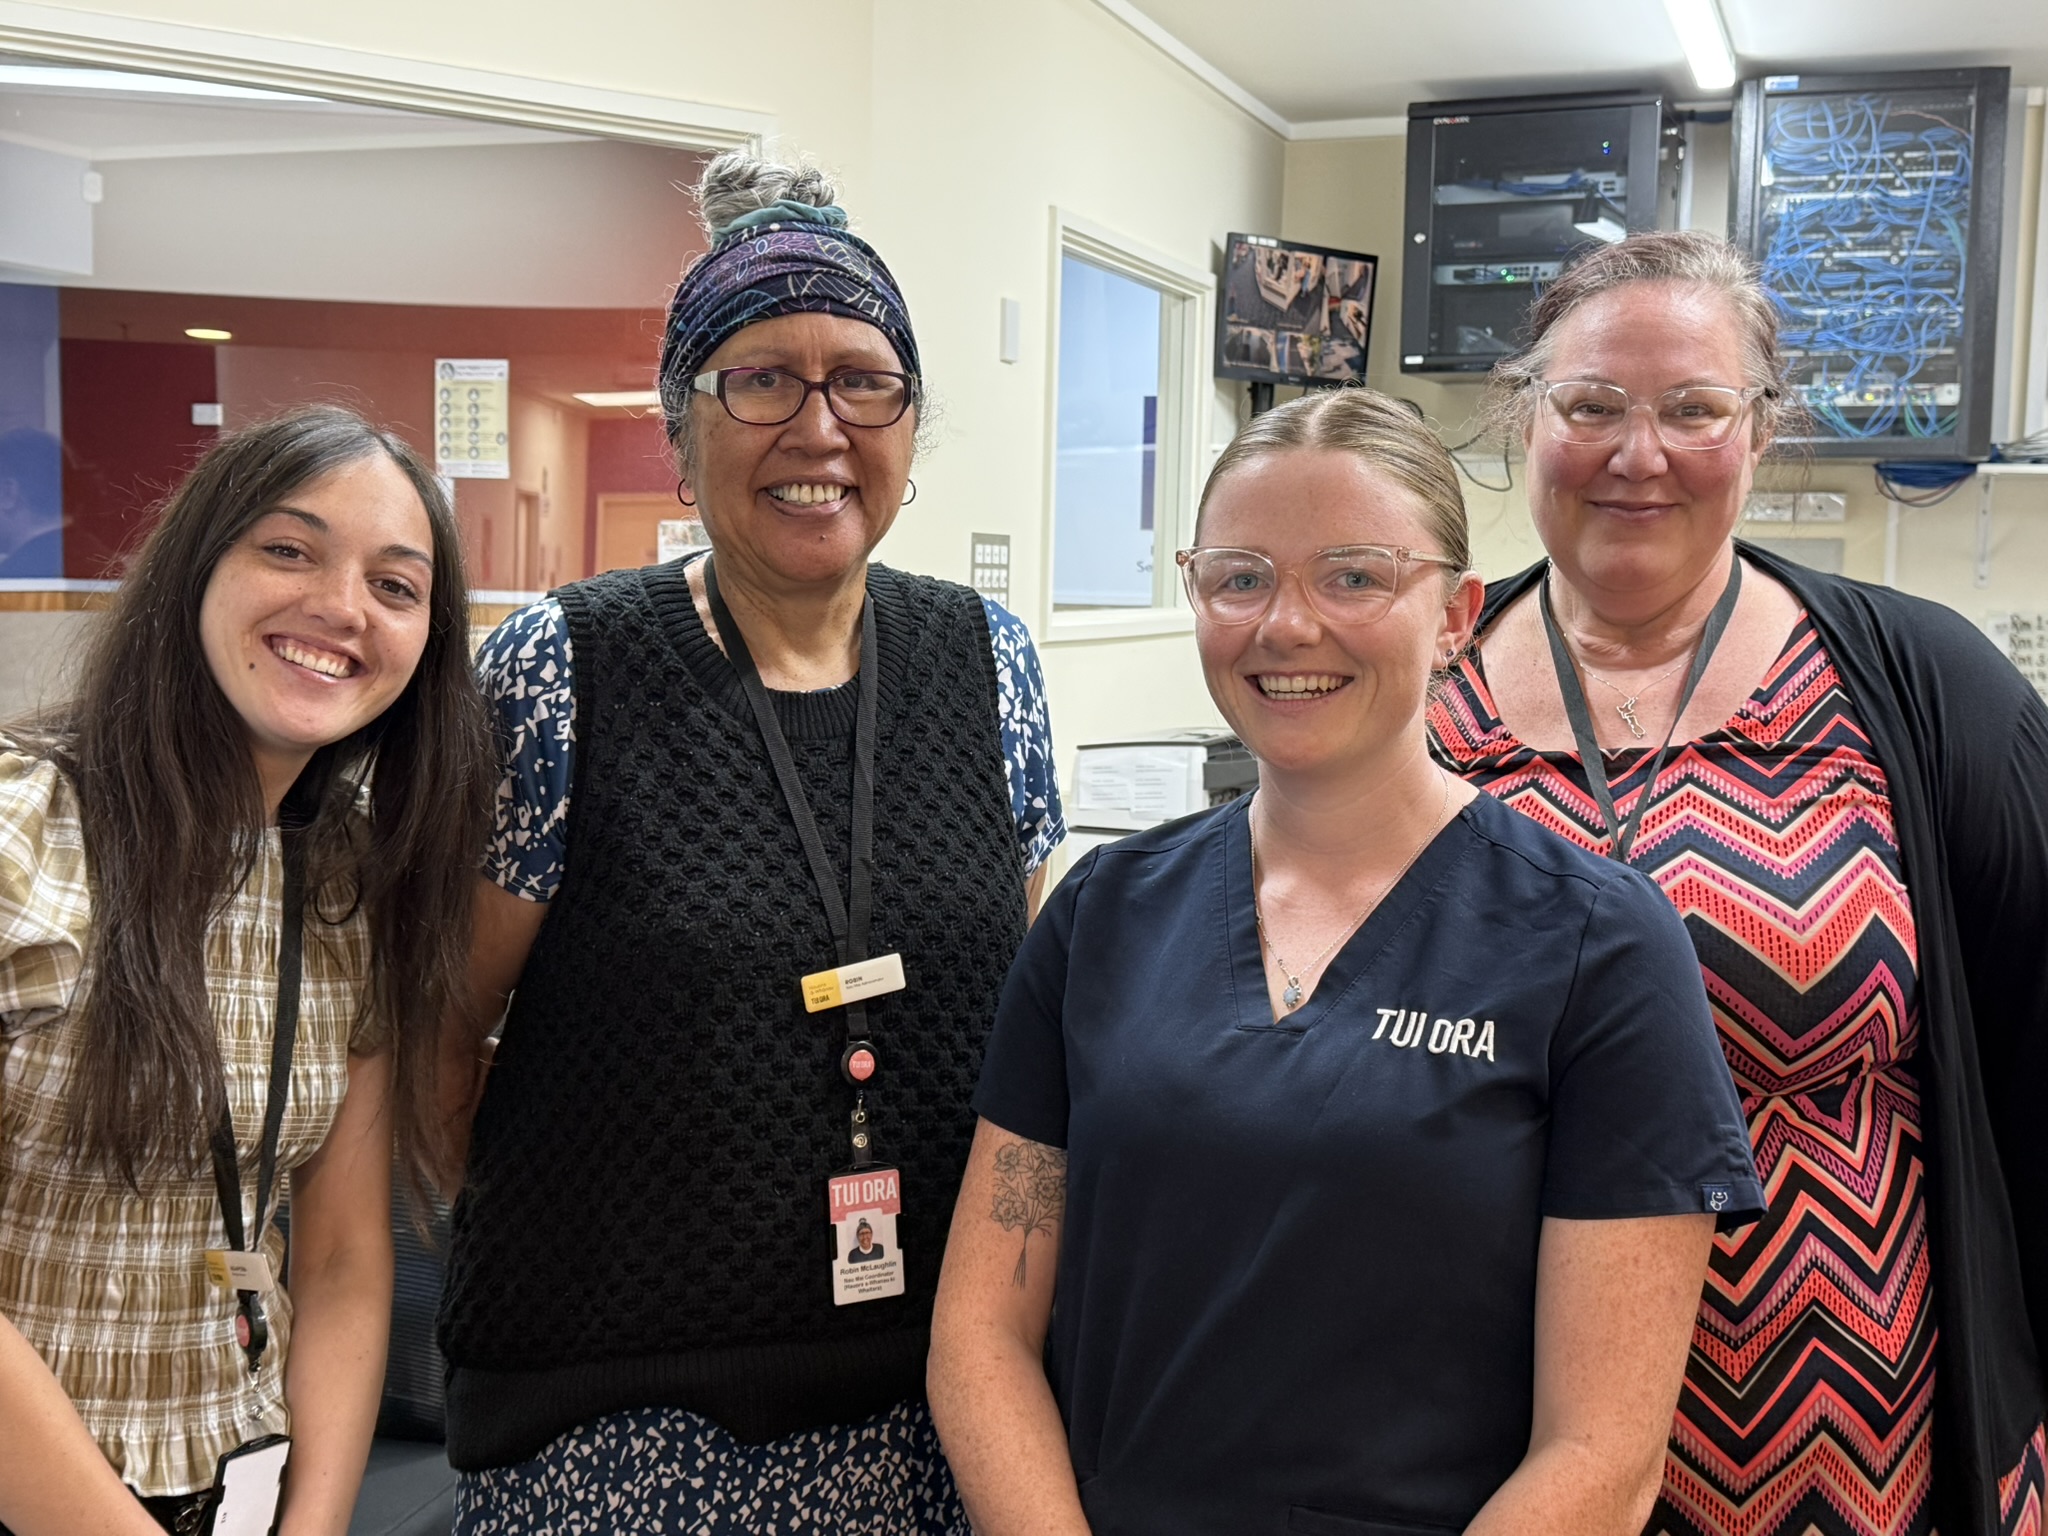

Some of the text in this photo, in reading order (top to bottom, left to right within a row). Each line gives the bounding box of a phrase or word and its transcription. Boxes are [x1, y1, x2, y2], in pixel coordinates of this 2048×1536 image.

[845, 976, 863, 985] ROBIN
[1371, 1008, 1495, 1063] TUI ORA
[831, 1177, 897, 1208] TUI ORA
[840, 1261, 897, 1276] Robin McLaughlin
[864, 1270, 894, 1280] Coordinator
